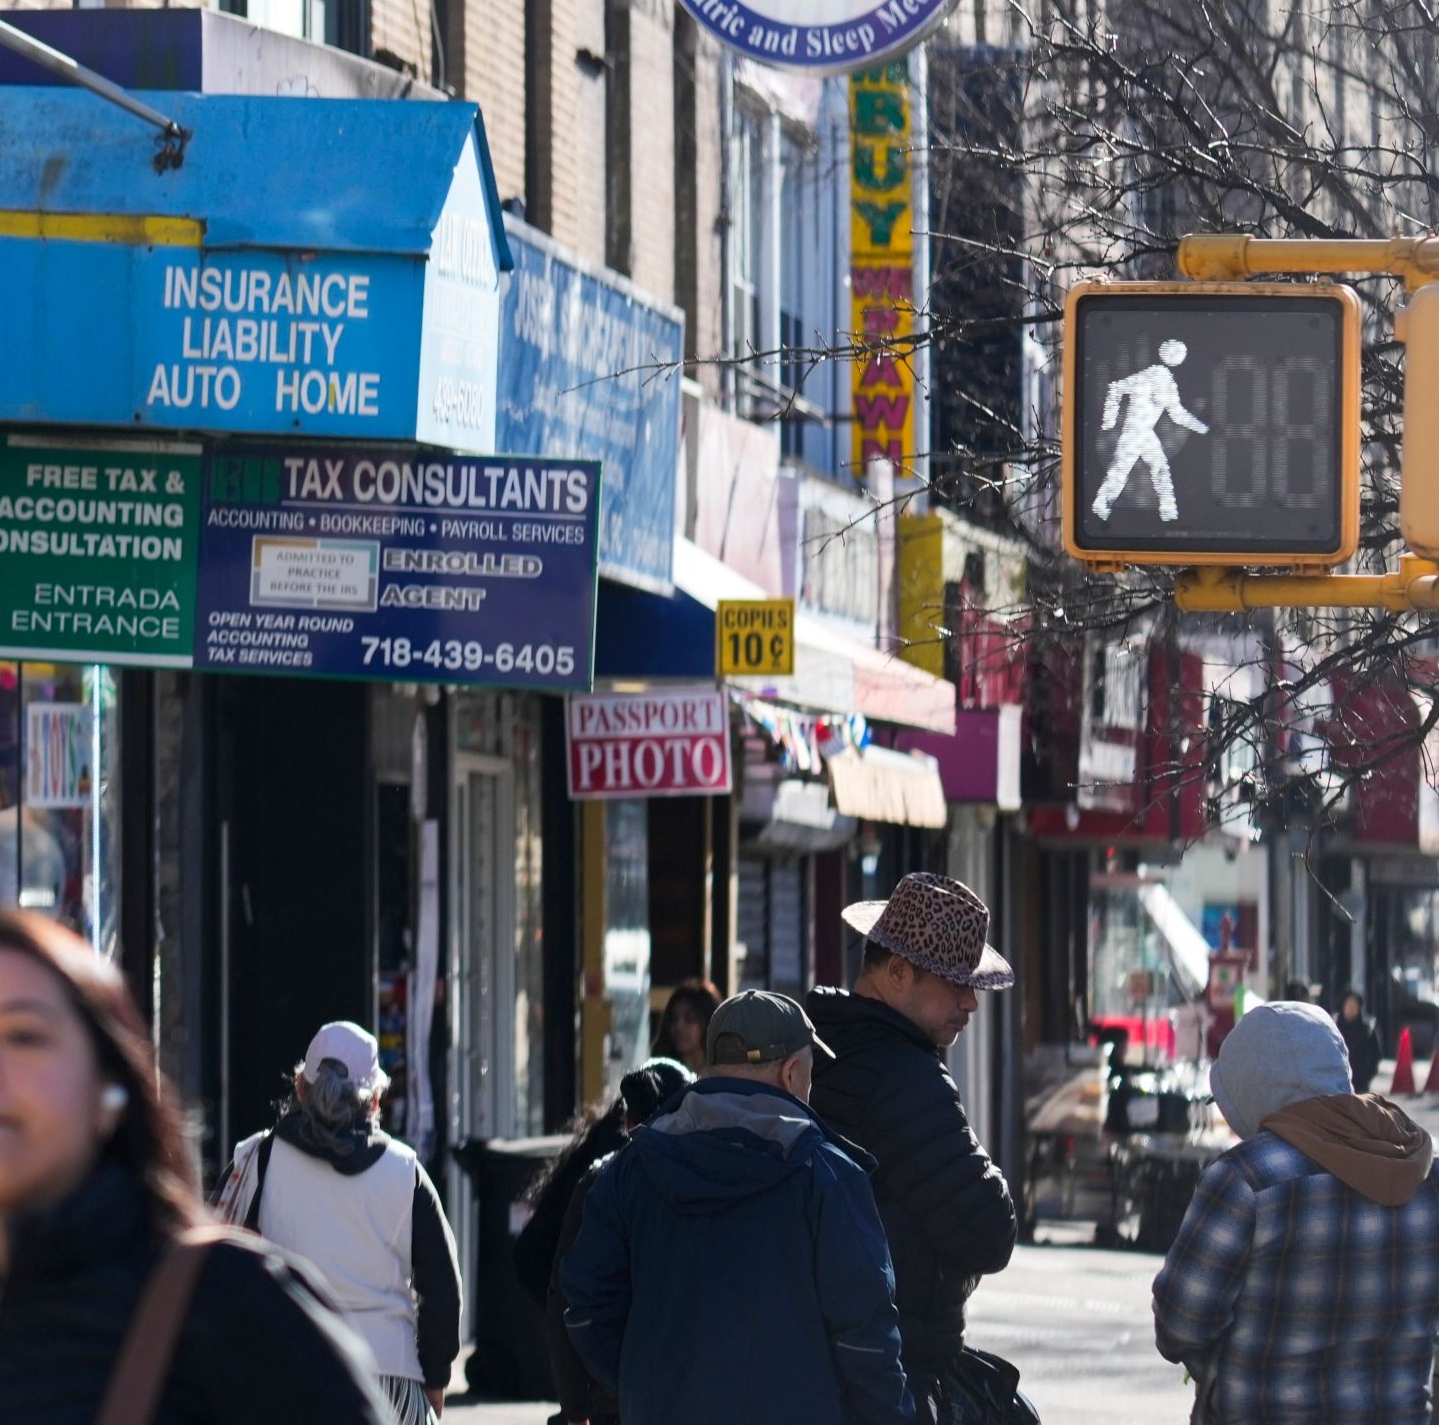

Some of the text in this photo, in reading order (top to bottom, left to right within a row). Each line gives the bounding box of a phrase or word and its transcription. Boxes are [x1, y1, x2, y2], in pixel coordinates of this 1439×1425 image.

[749, 26, 796, 55] and
[806, 23, 875, 58] Sleep
[854, 90, 907, 246] BUY
[164, 267, 369, 319] INSURANCE
[182, 316, 344, 365] LIABILITY
[147, 366, 379, 415] AUTO HOME
[27, 465, 157, 493] FREE TAX
[285, 458, 344, 500] TAX
[353, 461, 587, 512] CONSULTANTS
[208, 509, 584, 544] ACCOUNTING BOOKKEEPING PAYROLL SERVICES
[383, 548, 542, 577] ENROLLED
[35, 583, 180, 611] ENTRADA
[380, 583, 486, 610] AGENT
[12, 611, 179, 639] ENTRANCE
[209, 612, 353, 633] OPEN YEAR ROUND
[725, 607, 787, 628] COPIES
[207, 631, 308, 647] ACCOUNTING
[208, 647, 312, 665] TAX SERVICES
[361, 637, 575, 675] 718-439-6405
[579, 699, 716, 733] PASSPORT
[579, 737, 723, 789] PHOTO
